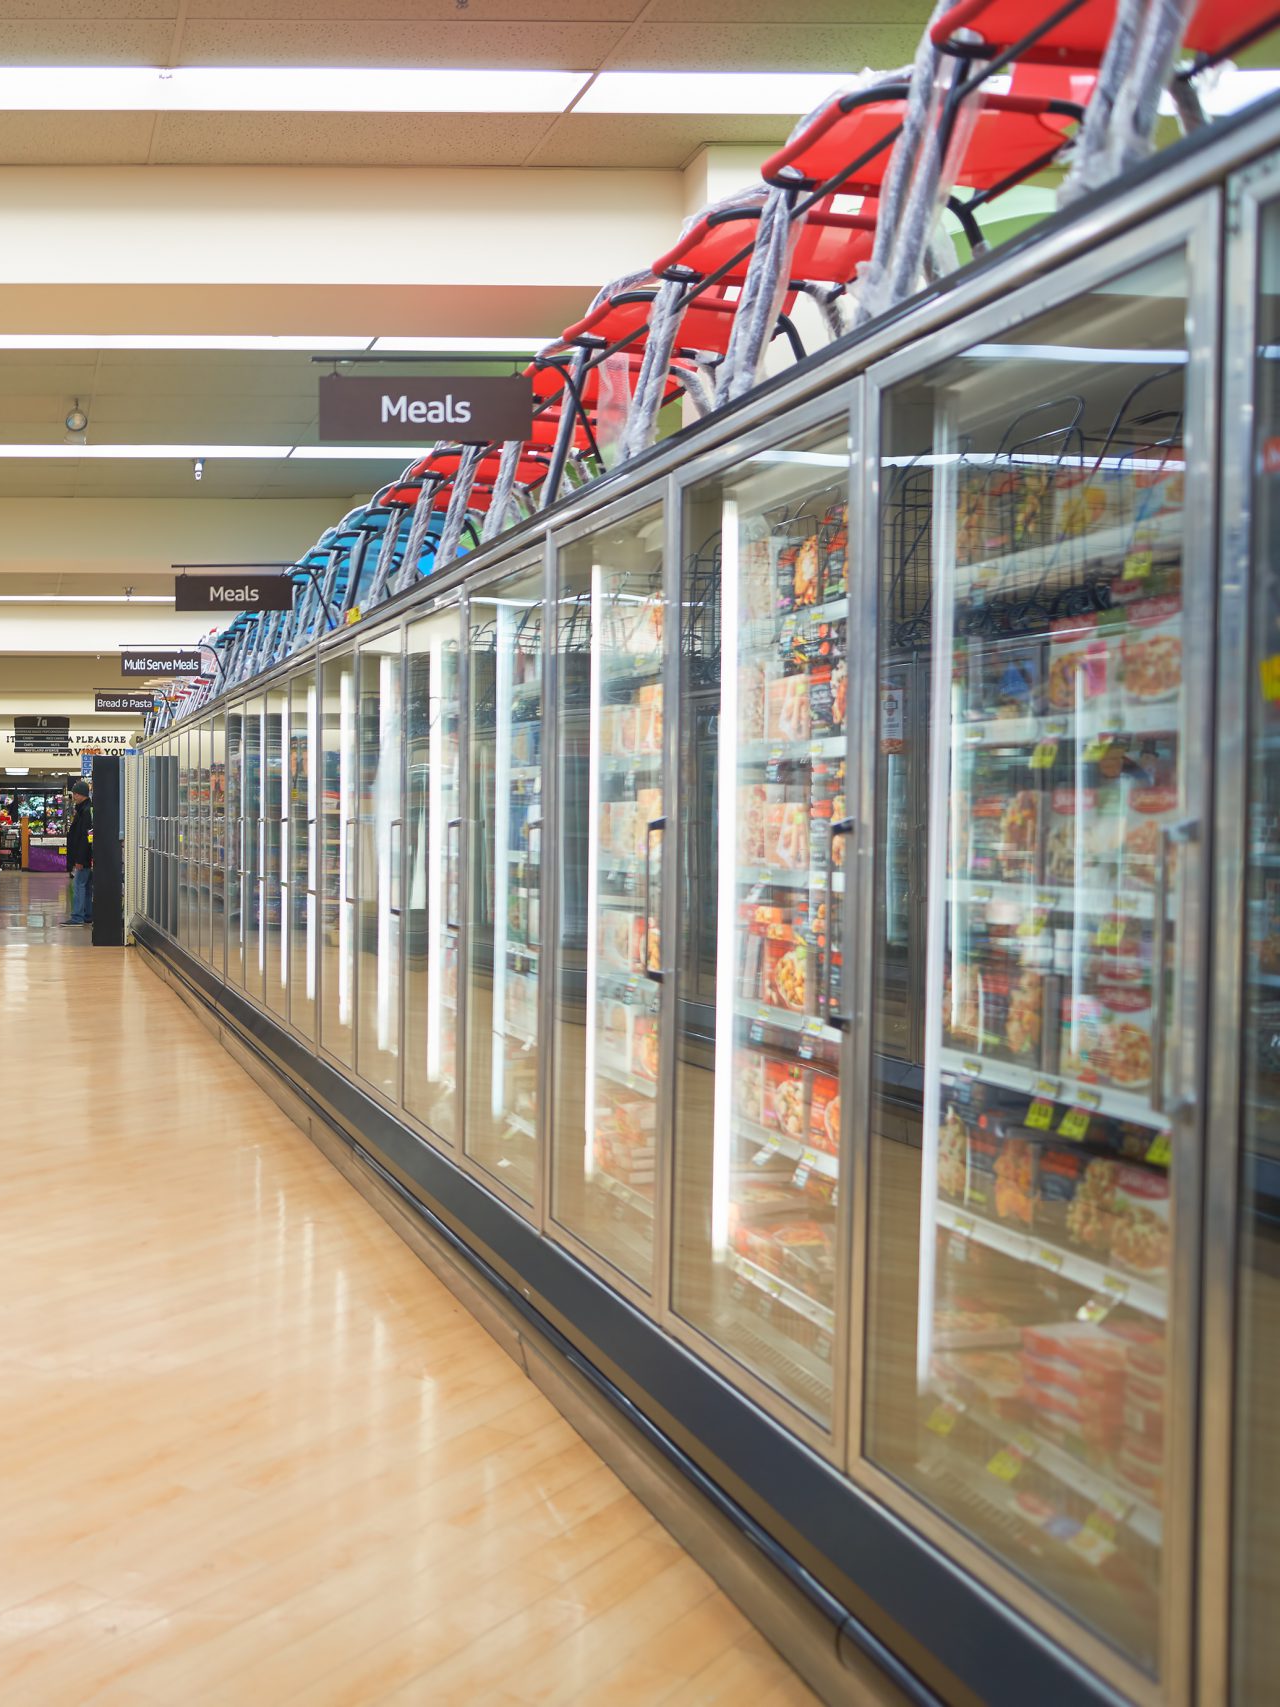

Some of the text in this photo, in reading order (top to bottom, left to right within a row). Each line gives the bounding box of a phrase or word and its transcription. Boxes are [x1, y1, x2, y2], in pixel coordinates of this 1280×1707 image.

[381, 394, 471, 423] Meals
[209, 585, 260, 602] Meals
[124, 658, 199, 670] Multi Serve Meals
[96, 699, 153, 708] Bread & Pasta
[36, 716, 48, 727] 7a
[76, 735, 127, 743] PLEASURE
[104, 748, 126, 756] YOU
